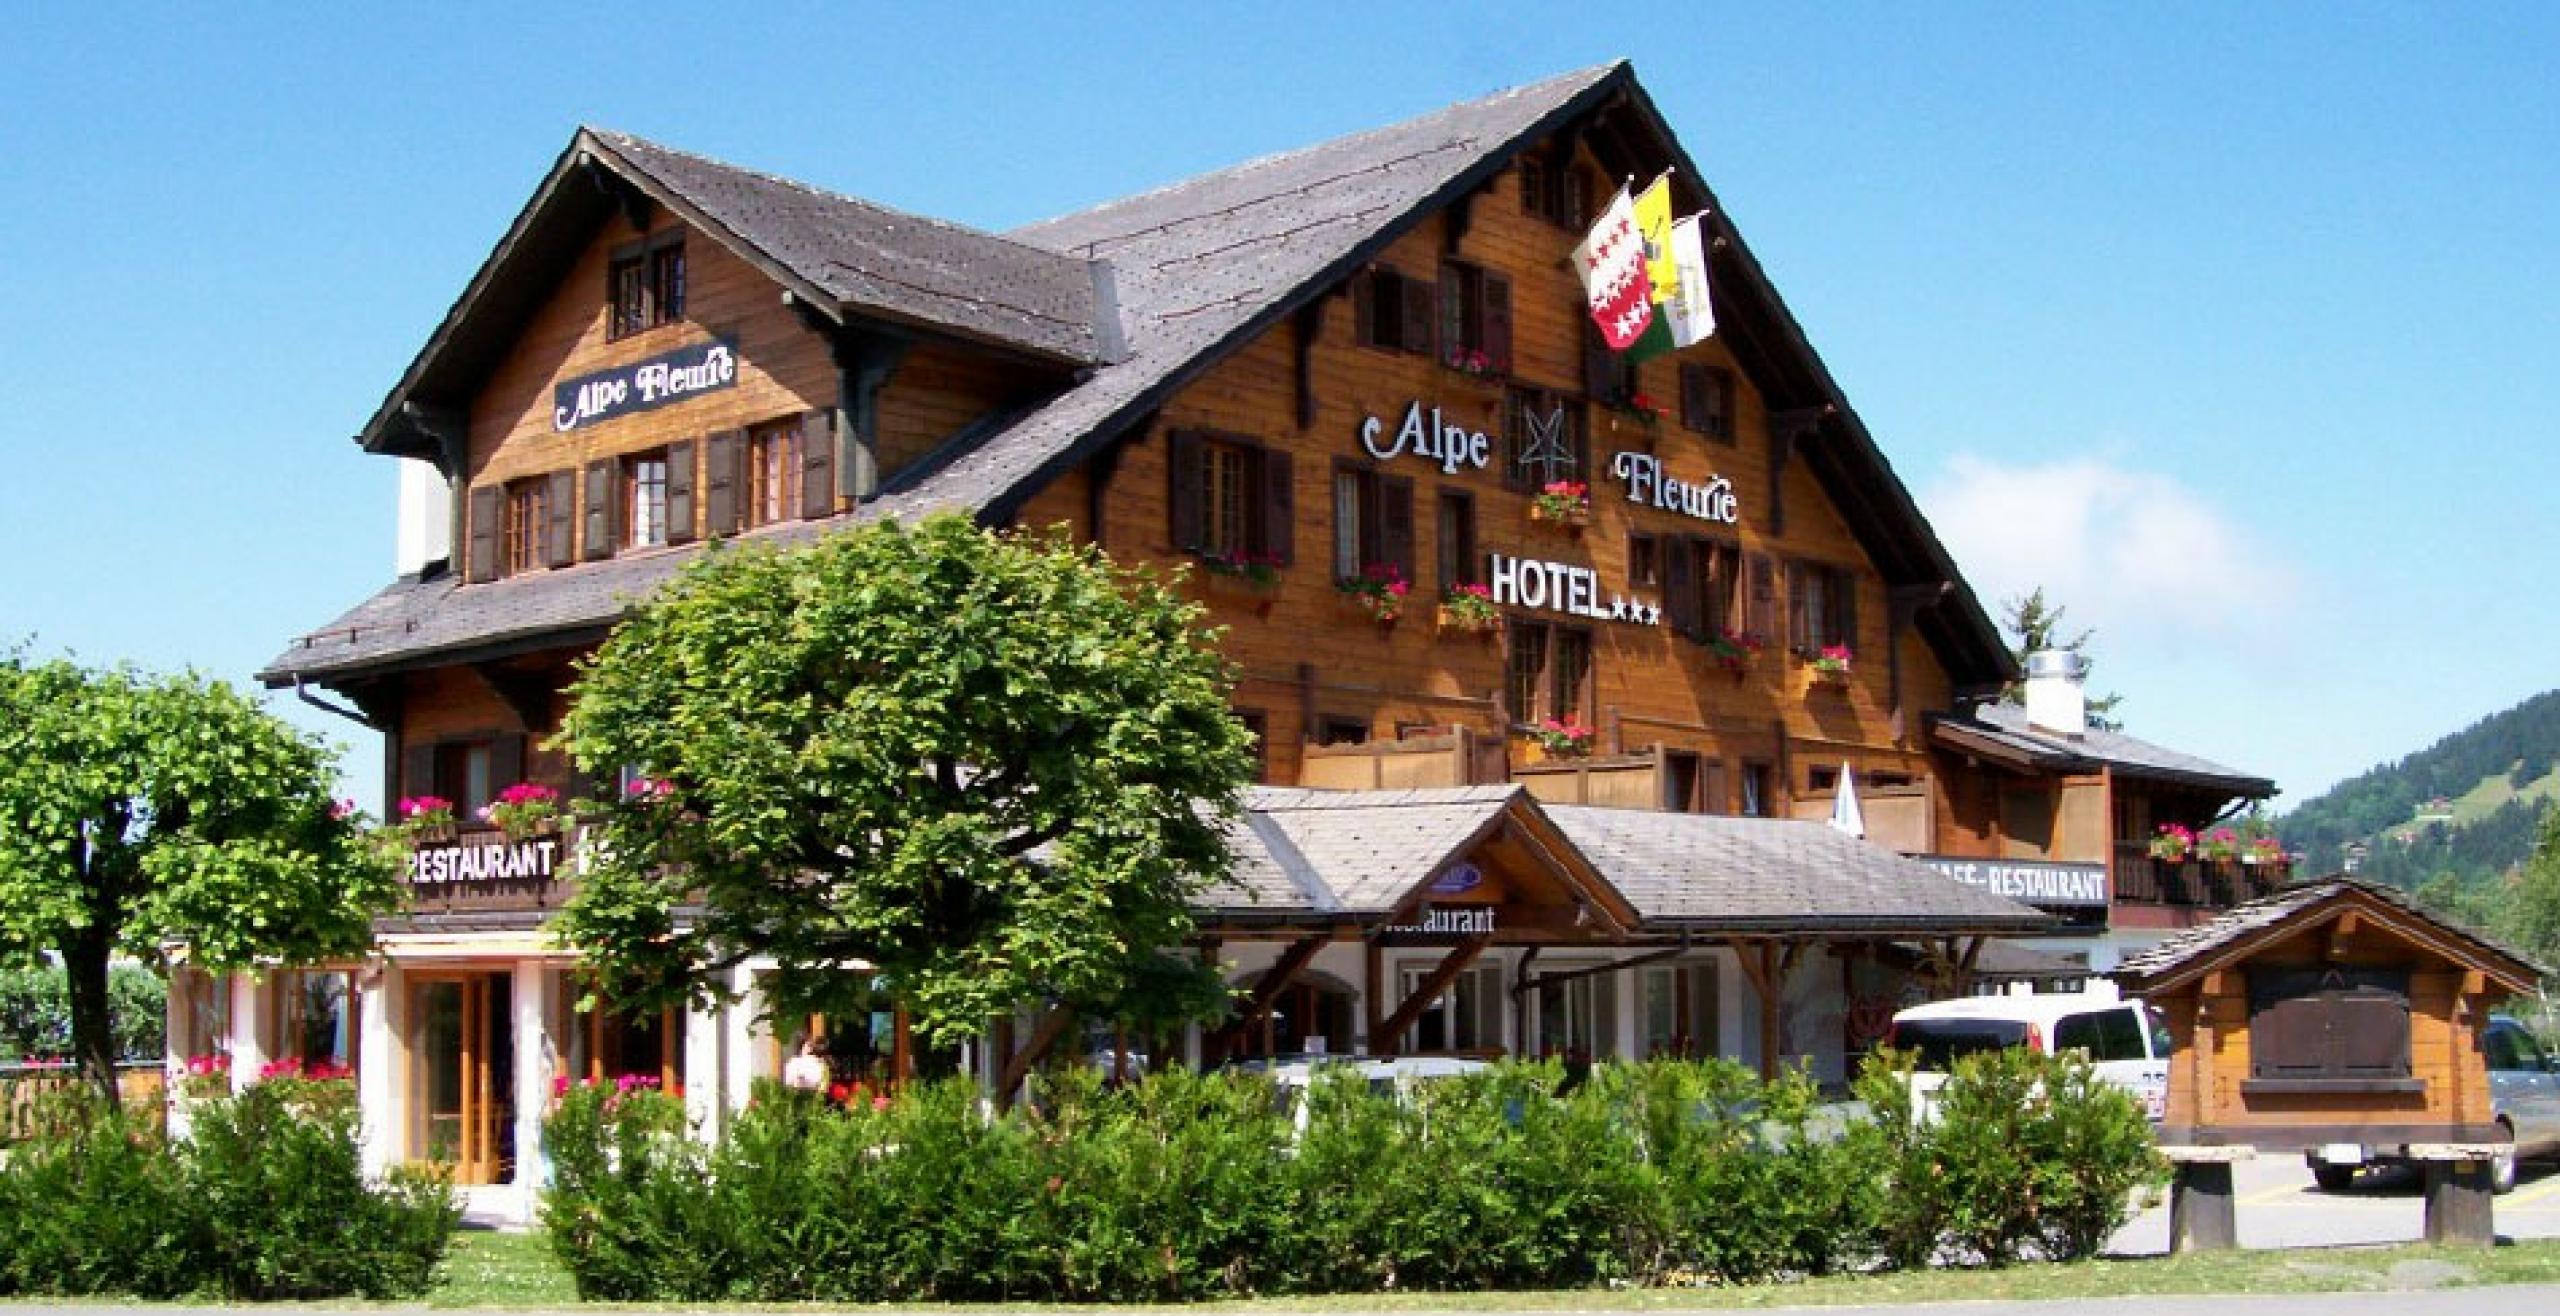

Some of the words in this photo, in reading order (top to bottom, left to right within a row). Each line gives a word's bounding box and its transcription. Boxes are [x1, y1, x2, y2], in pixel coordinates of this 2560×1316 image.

[556, 379, 628, 431] Alpe
[635, 346, 733, 402] Fleurie
[1361, 400, 1490, 475] Alpe
[1614, 451, 1738, 523] Fleurie
[1491, 553, 1612, 620] HOTEL
[1385, 906, 1496, 934] aurant
